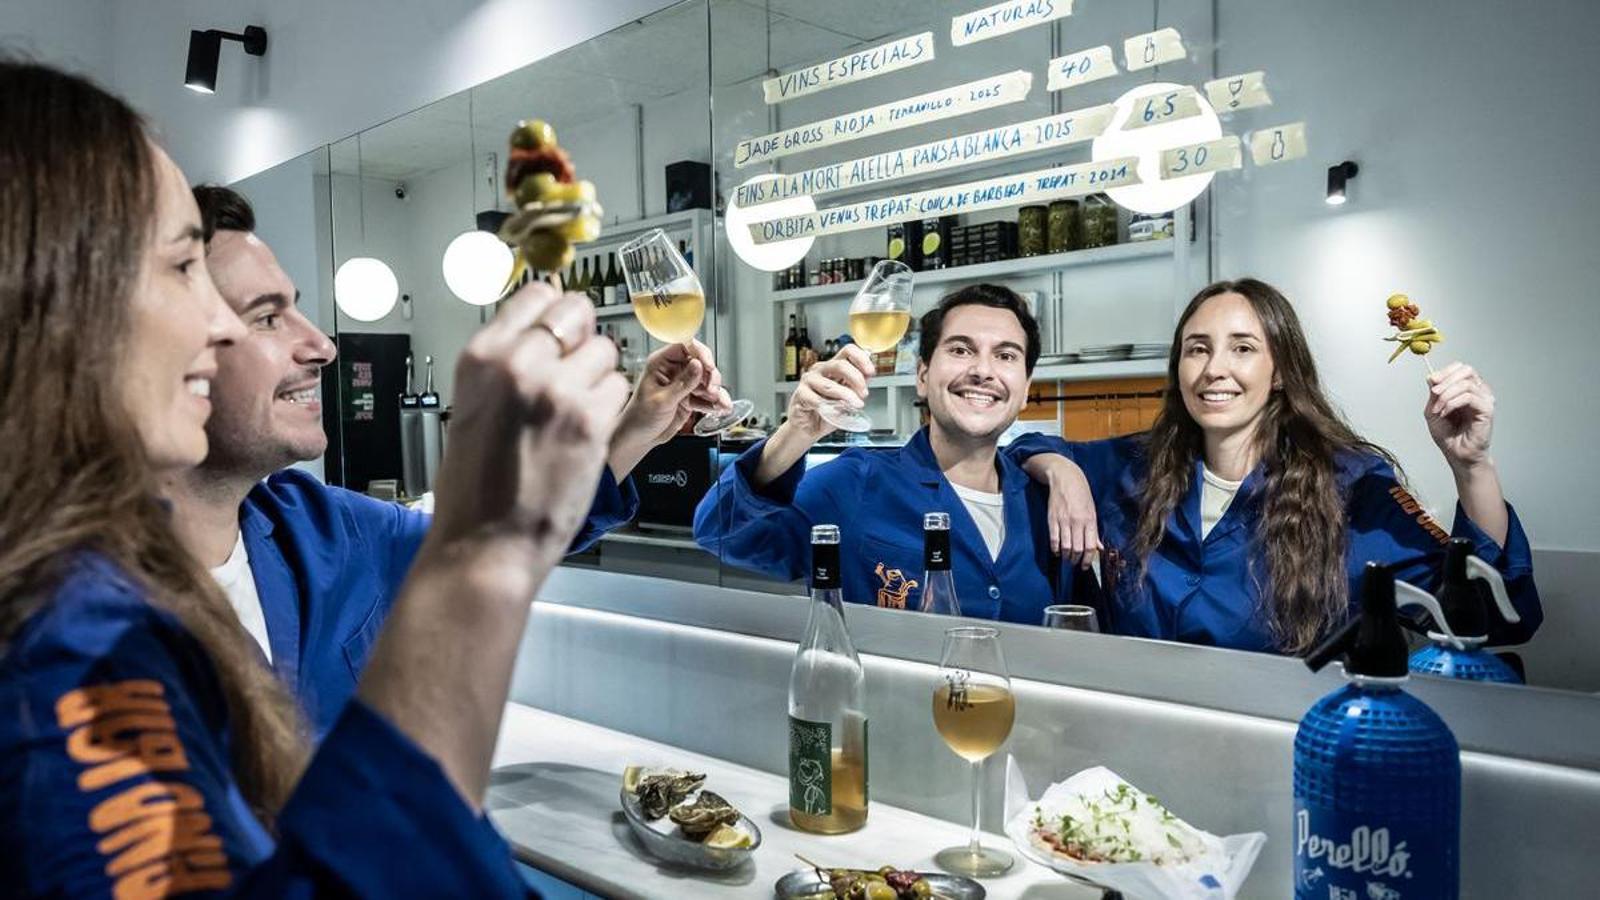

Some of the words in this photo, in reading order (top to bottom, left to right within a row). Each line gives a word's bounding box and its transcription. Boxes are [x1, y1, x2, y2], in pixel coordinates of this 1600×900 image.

[964, 0, 1054, 37] NATURALS
[779, 67, 819, 97] VINS
[828, 39, 923, 81] ESPECIALS
[1061, 56, 1091, 79] 40
[1142, 93, 1178, 123] 6.5
[737, 136, 779, 165] JADE
[784, 126, 823, 149] GROSS
[833, 114, 875, 135] RIOJA
[1172, 146, 1207, 173] 30
[737, 181, 765, 205] FINS
[802, 164, 843, 193] MORT
[819, 206, 860, 228] VENUS
[864, 198, 912, 221] TREPAT
